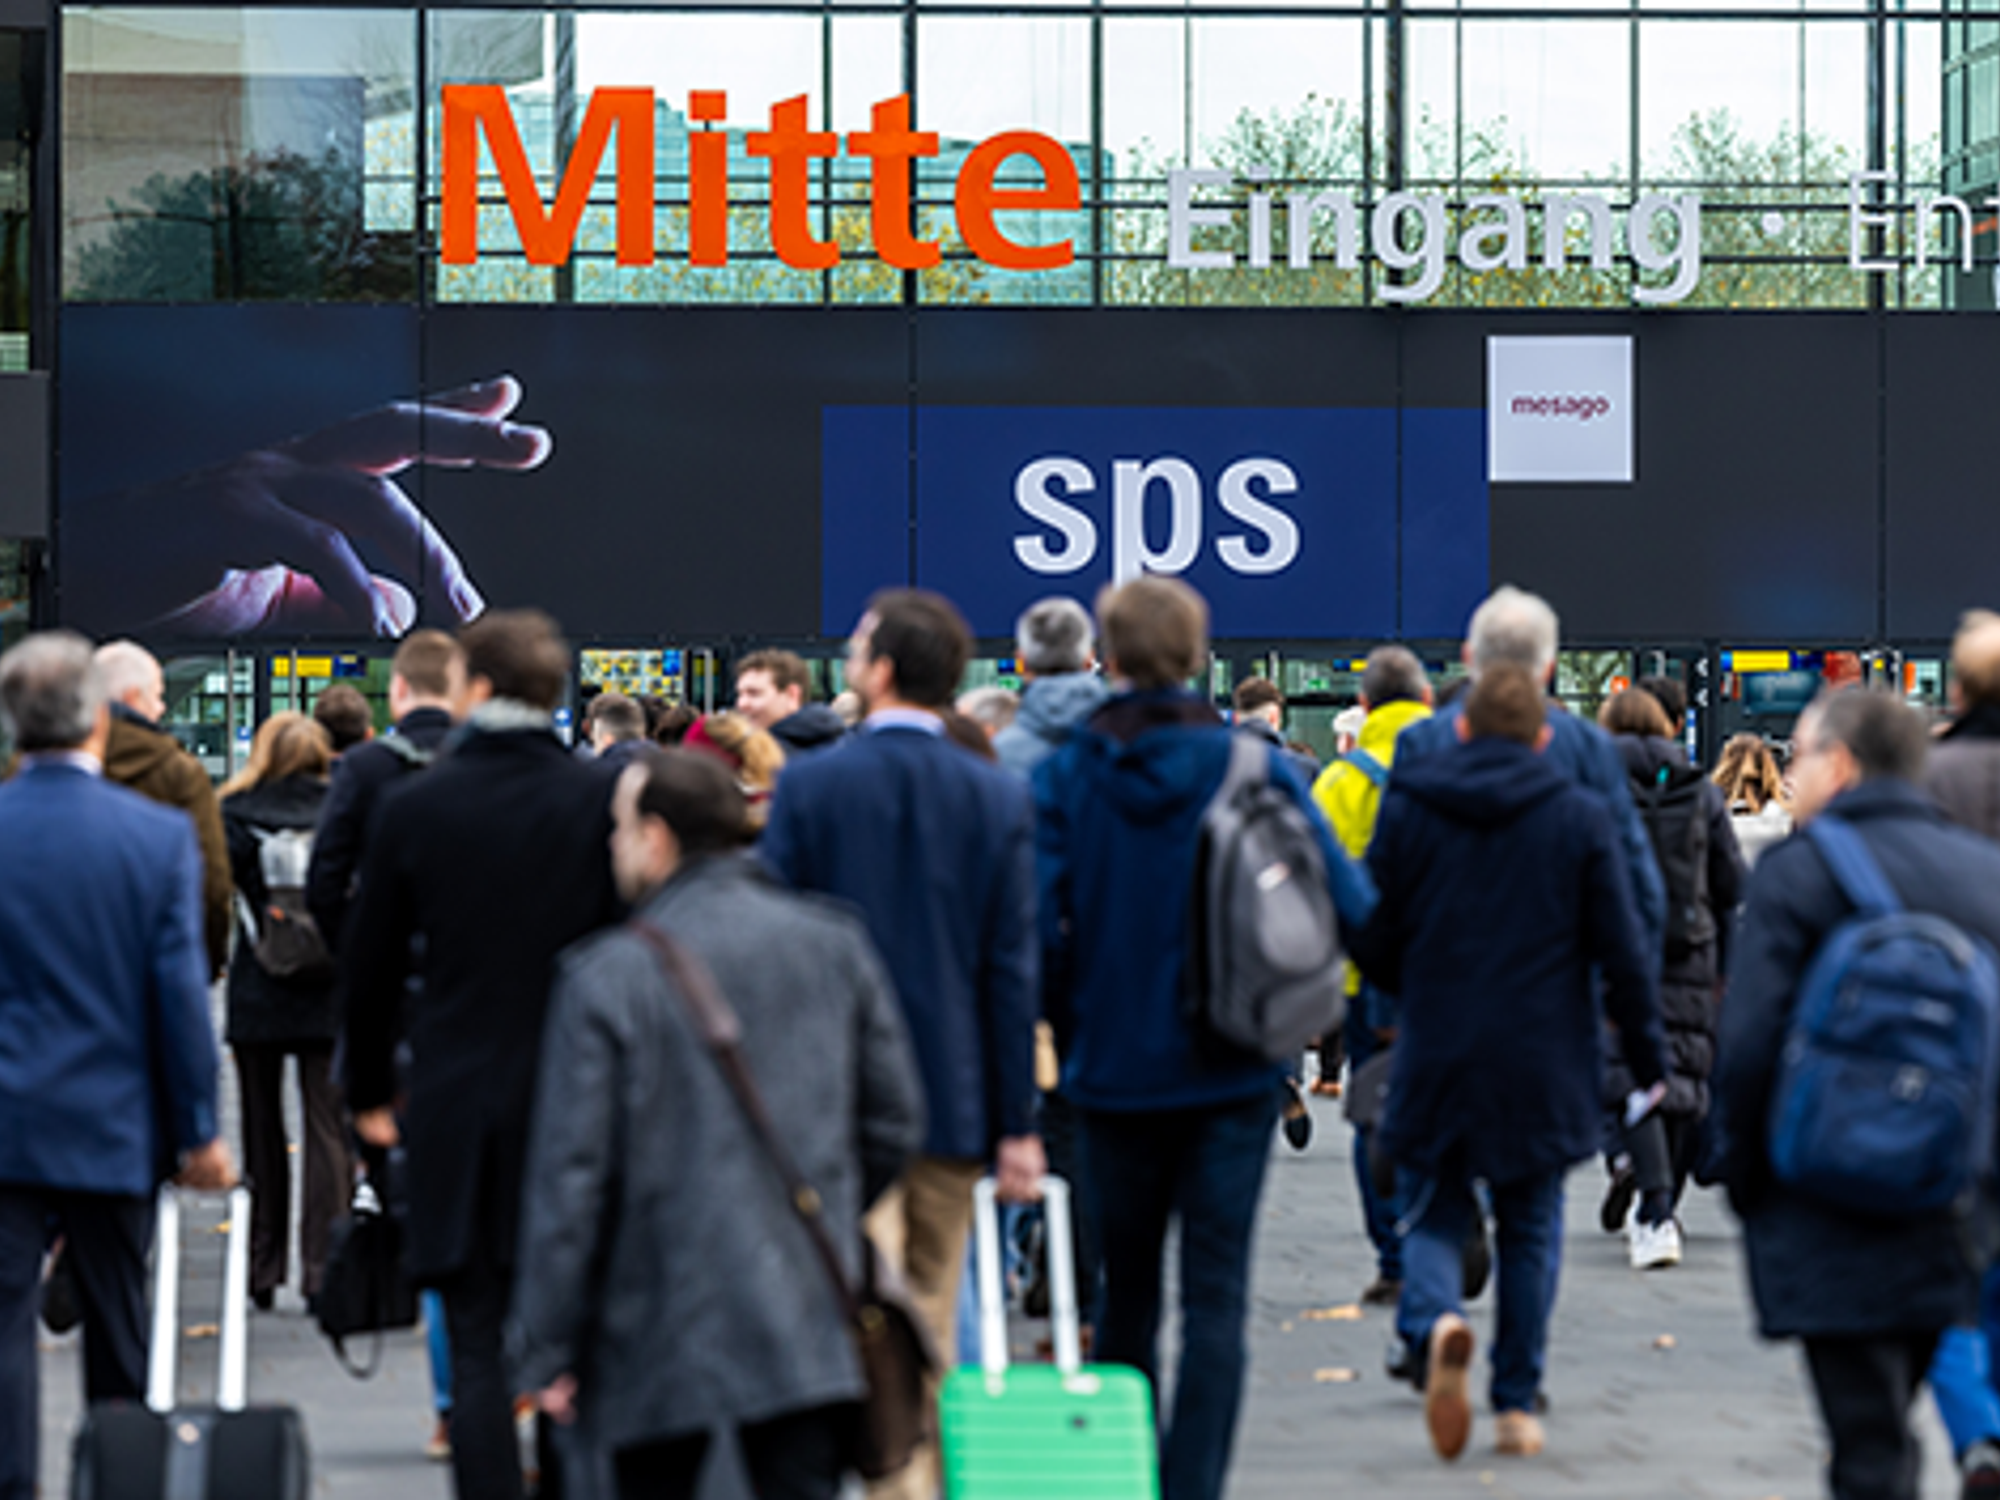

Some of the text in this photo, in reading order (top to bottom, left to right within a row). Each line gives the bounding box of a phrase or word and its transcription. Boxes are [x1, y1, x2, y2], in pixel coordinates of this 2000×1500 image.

[441, 85, 2000, 302] Mitte Eingang En
[1511, 396, 1610, 420] mesago
[1013, 457, 1300, 590] sps
